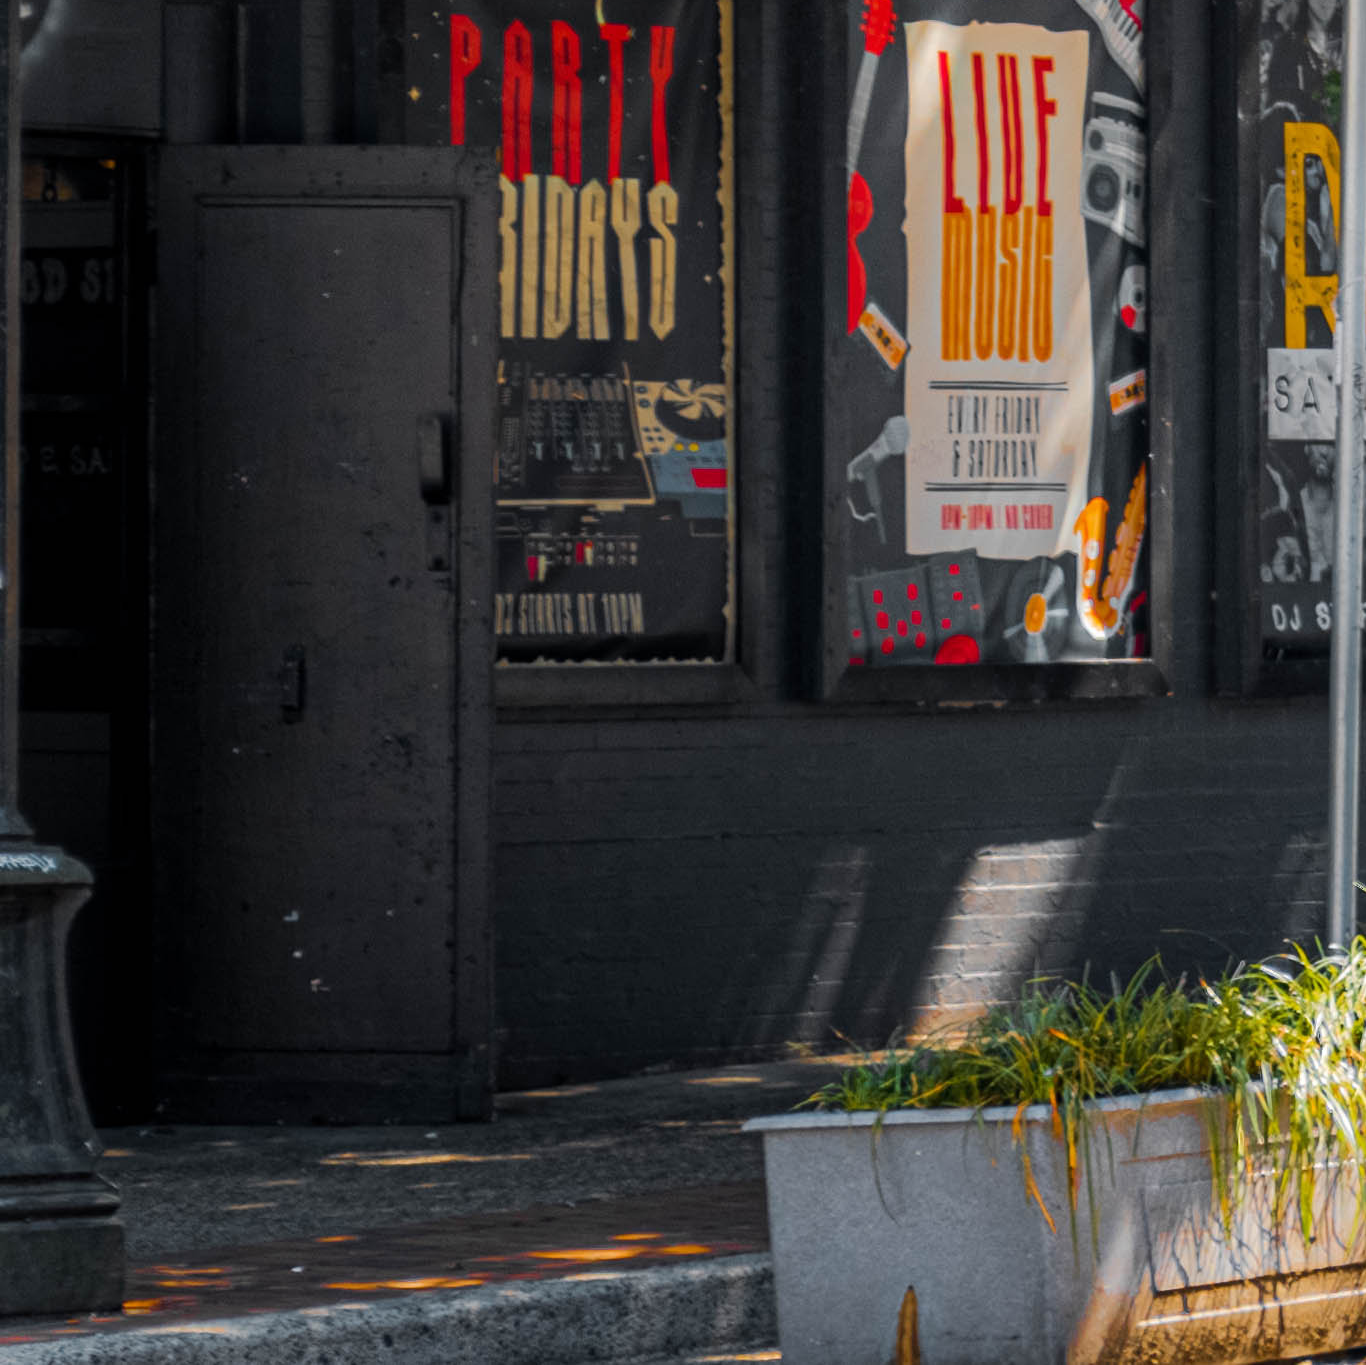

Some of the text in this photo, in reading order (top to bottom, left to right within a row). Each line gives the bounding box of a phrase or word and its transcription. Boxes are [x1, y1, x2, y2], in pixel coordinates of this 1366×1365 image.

[450, 13, 676, 185] PARTY
[937, 50, 1057, 218] LIVE
[499, 172, 679, 341] RIDAYS
[948, 394, 988, 435] EVRY
[968, 439, 1038, 479] SATURDAY
[1271, 602, 1302, 632] DJ
